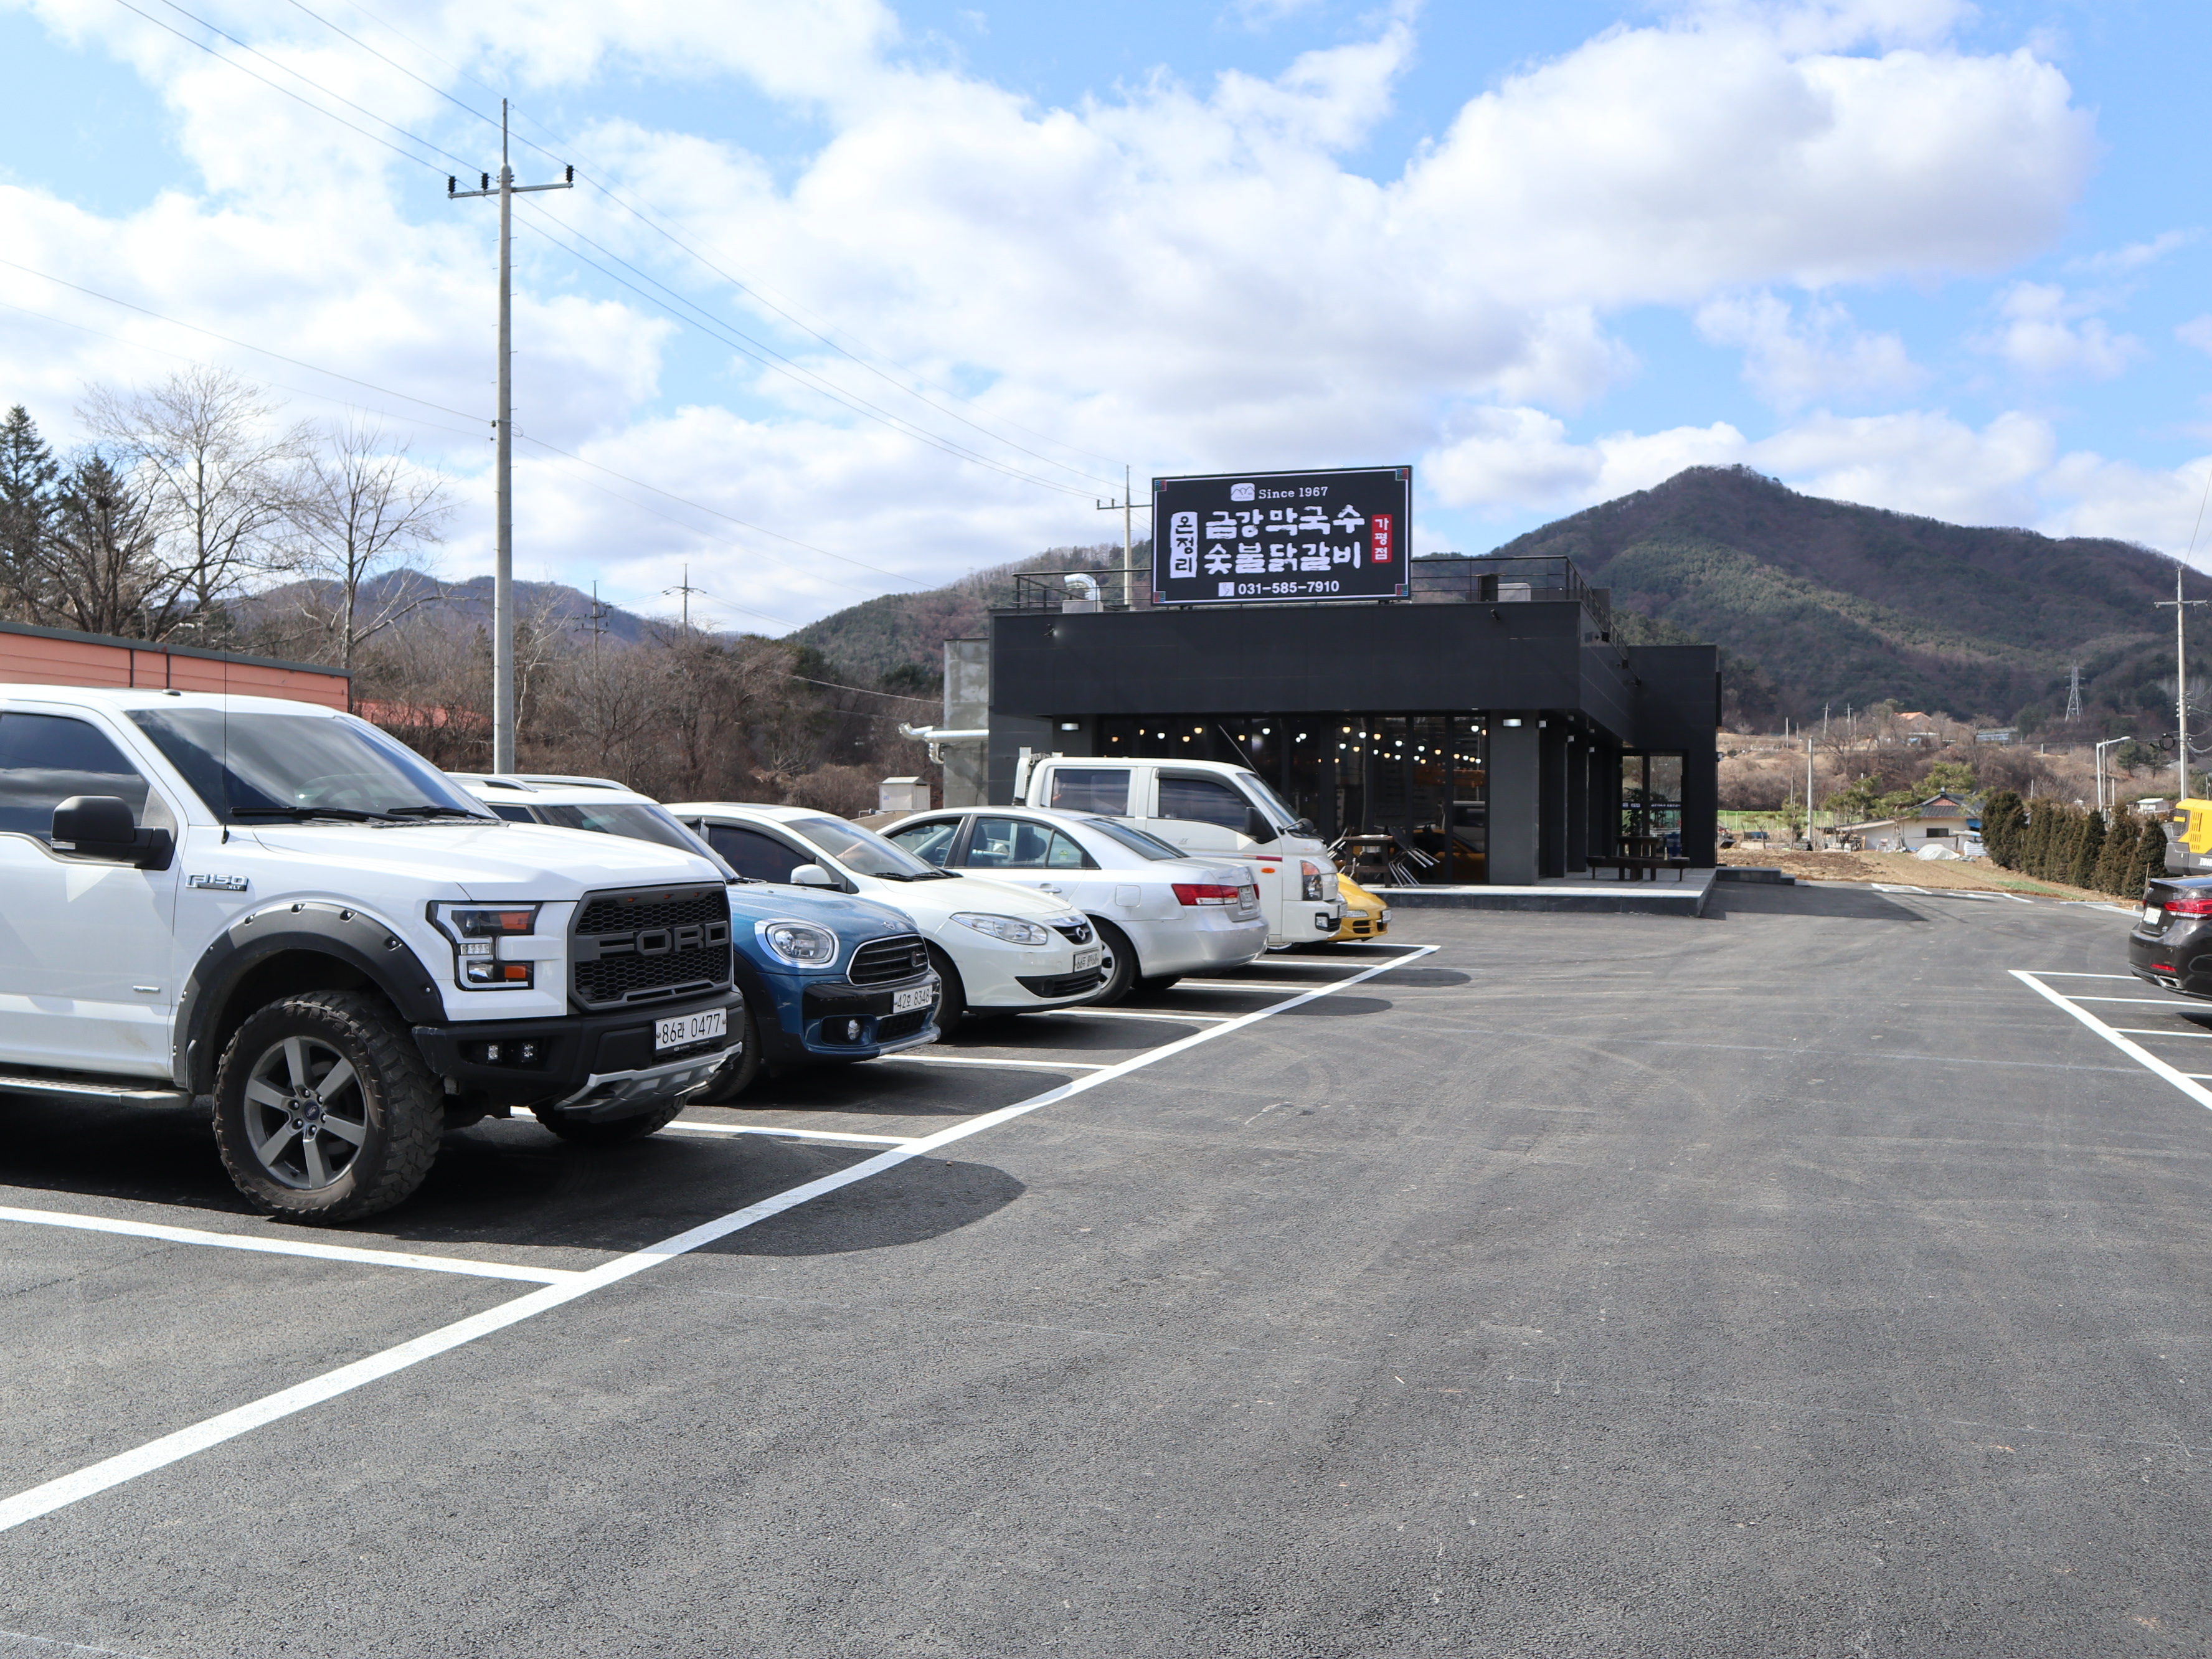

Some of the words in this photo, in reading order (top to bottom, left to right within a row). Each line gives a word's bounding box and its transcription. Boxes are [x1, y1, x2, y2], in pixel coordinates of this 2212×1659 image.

[1258, 488, 1295, 499] Since
[1298, 486, 1328, 498] 1967
[1175, 516, 1194, 573] 온정리
[1374, 518, 1390, 560] 가평점
[1204, 541, 1361, 574] 숯불닭갈비
[1238, 580, 1340, 595] 031-585-7910
[592, 920, 729, 960] FORD
[914, 988, 930, 1006] 8348
[662, 1021, 685, 1044] 86라
[691, 1013, 721, 1037] 0477
